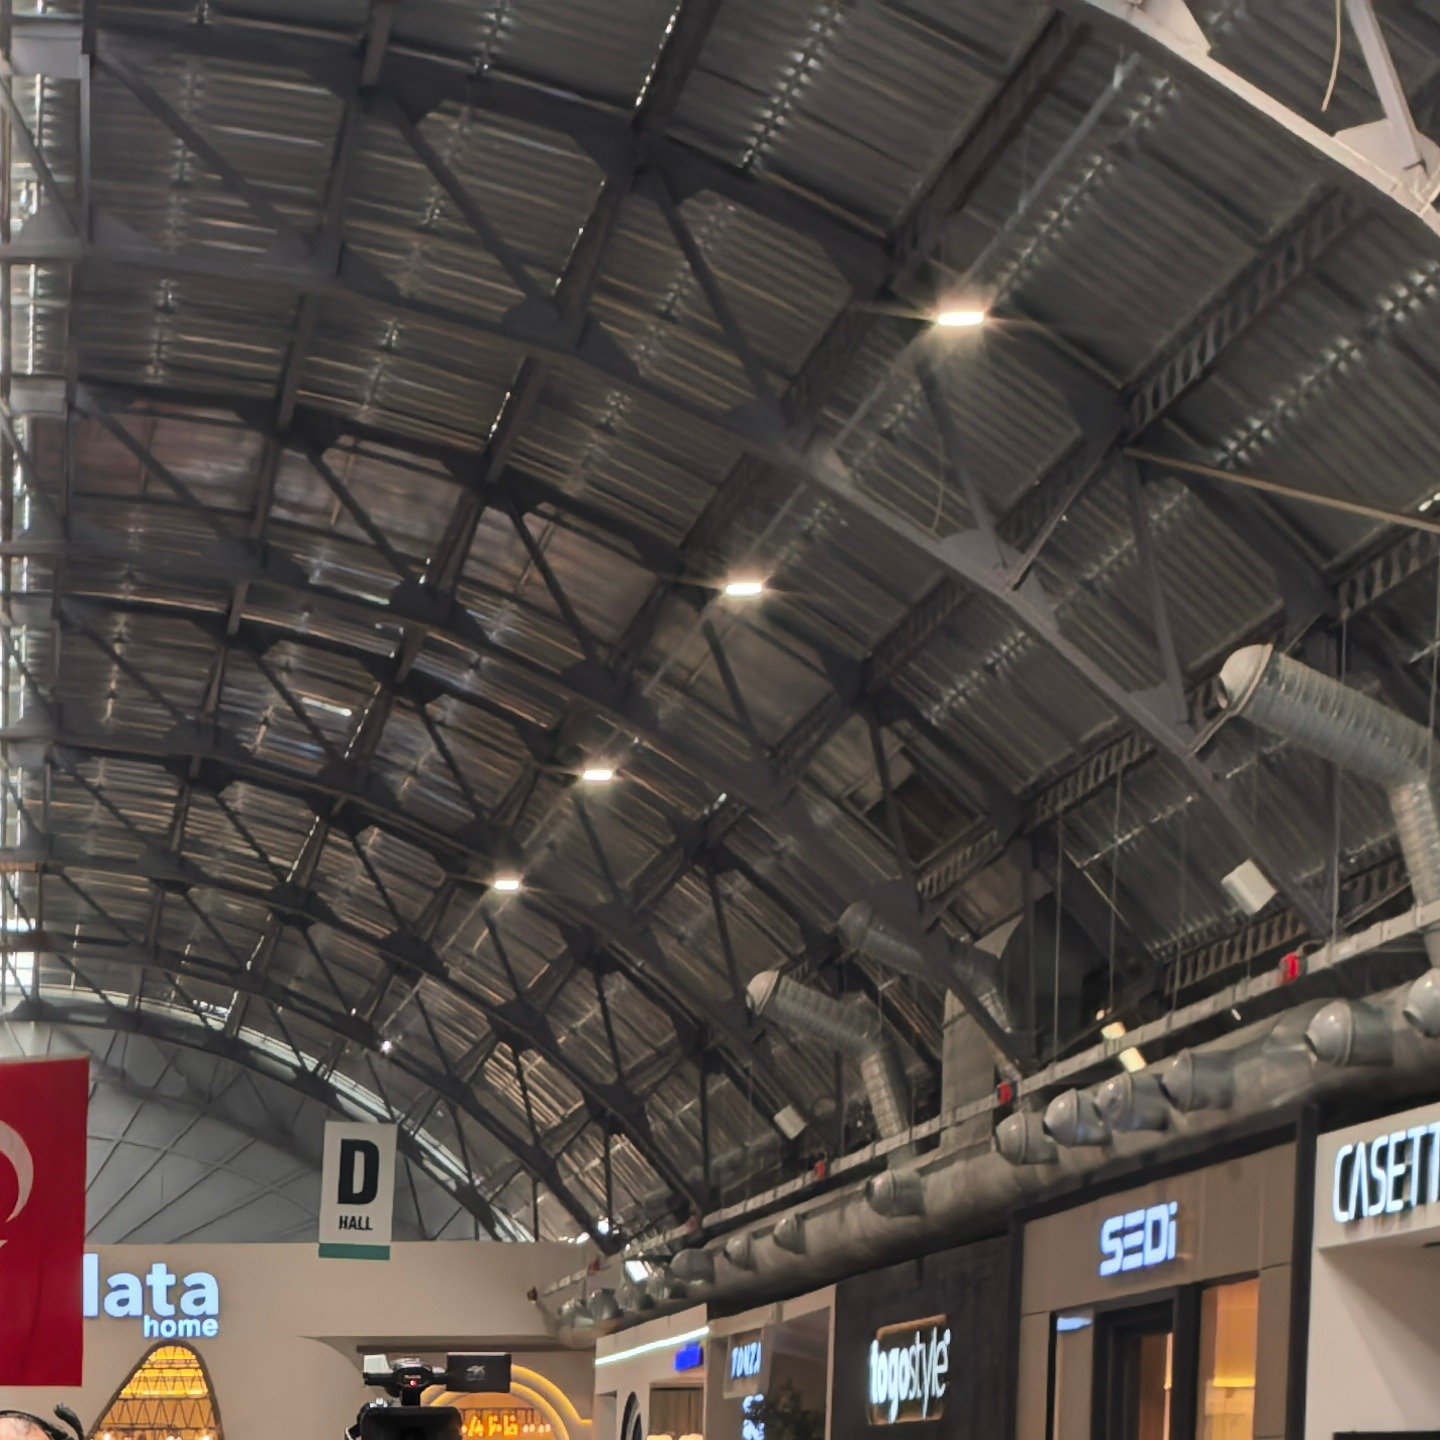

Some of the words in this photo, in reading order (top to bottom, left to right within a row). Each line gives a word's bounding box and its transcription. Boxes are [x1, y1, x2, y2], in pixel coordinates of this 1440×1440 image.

[337, 1139, 380, 1205] D
[338, 1215, 373, 1231] HALL
[143, 1314, 219, 1339] home
